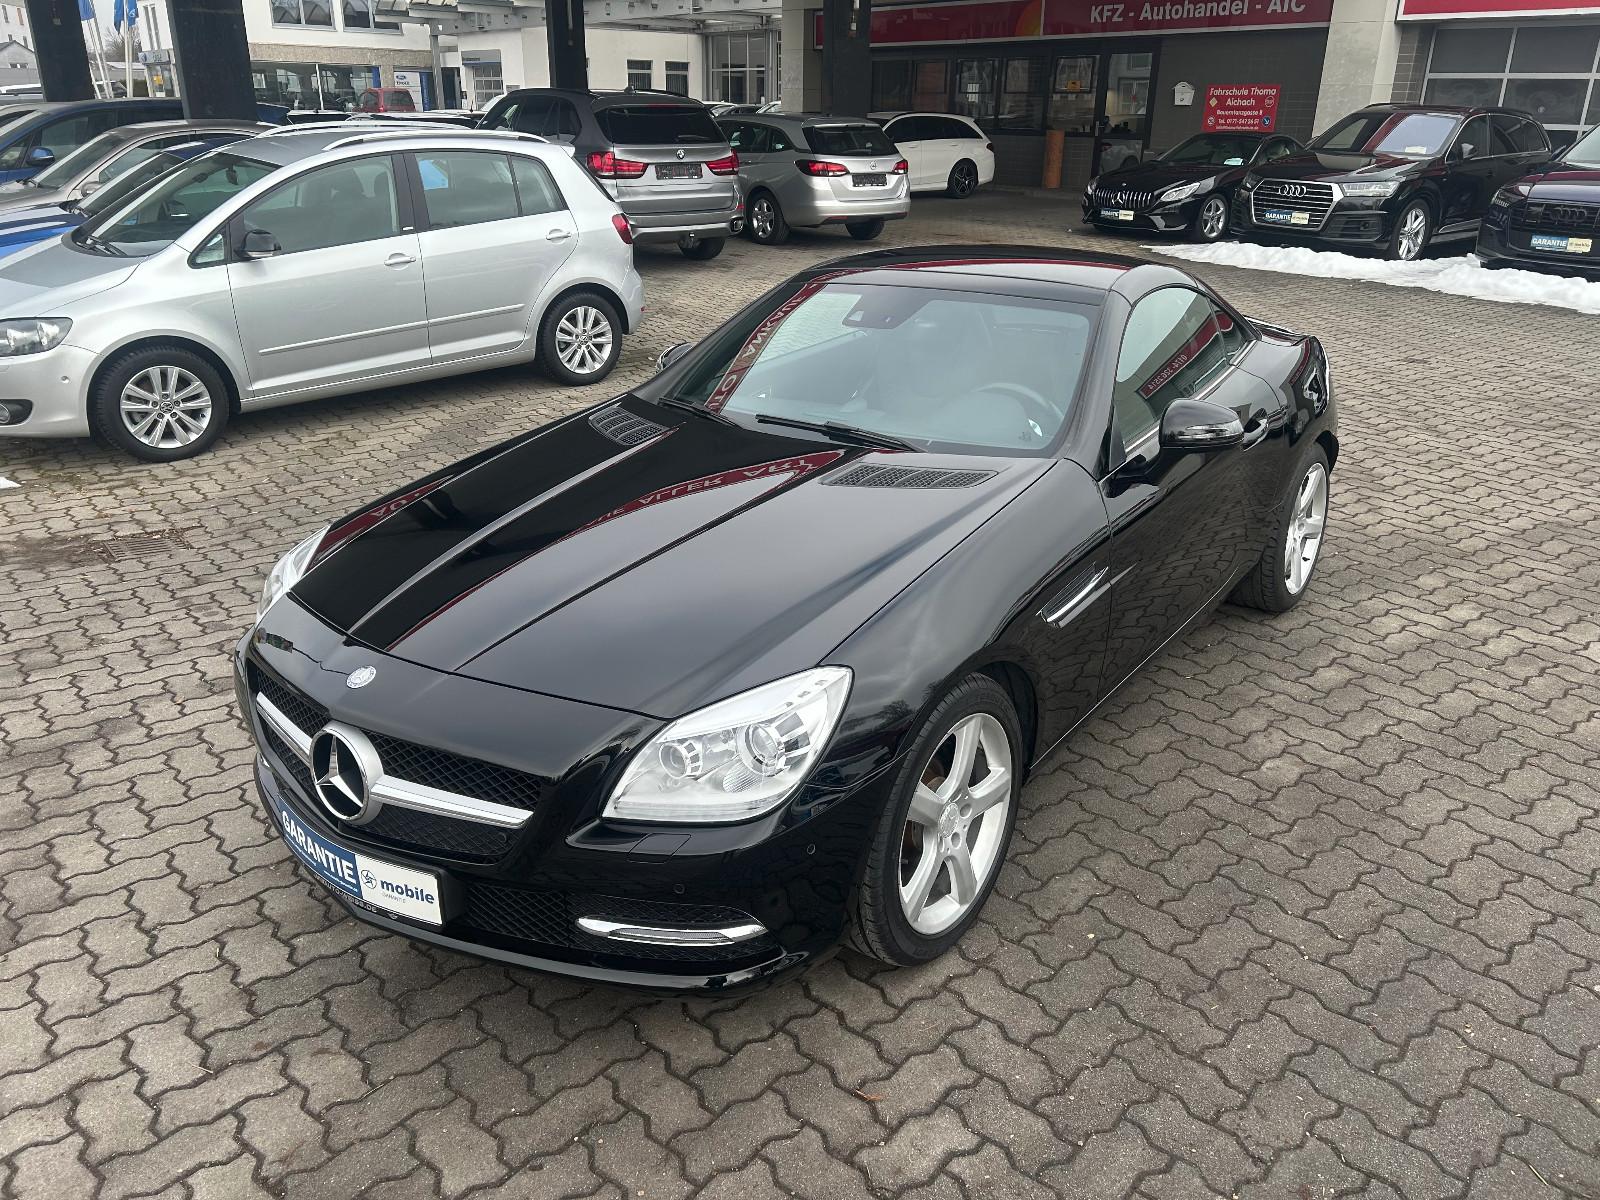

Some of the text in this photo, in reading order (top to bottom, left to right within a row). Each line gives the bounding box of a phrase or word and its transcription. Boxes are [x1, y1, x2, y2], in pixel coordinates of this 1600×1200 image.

[1090, 4, 1125, 23] KFZ
[1139, 0, 1249, 20] Autohandel
[1210, 86, 1277, 96] Fahrschule Thoma
[1225, 97, 1256, 106] Aichach
[1265, 212, 1292, 221] GARANTIE
[1532, 237, 1567, 247] GARANTIE
[281, 810, 357, 885] GARANTIE
[380, 880, 435, 905] mobile
